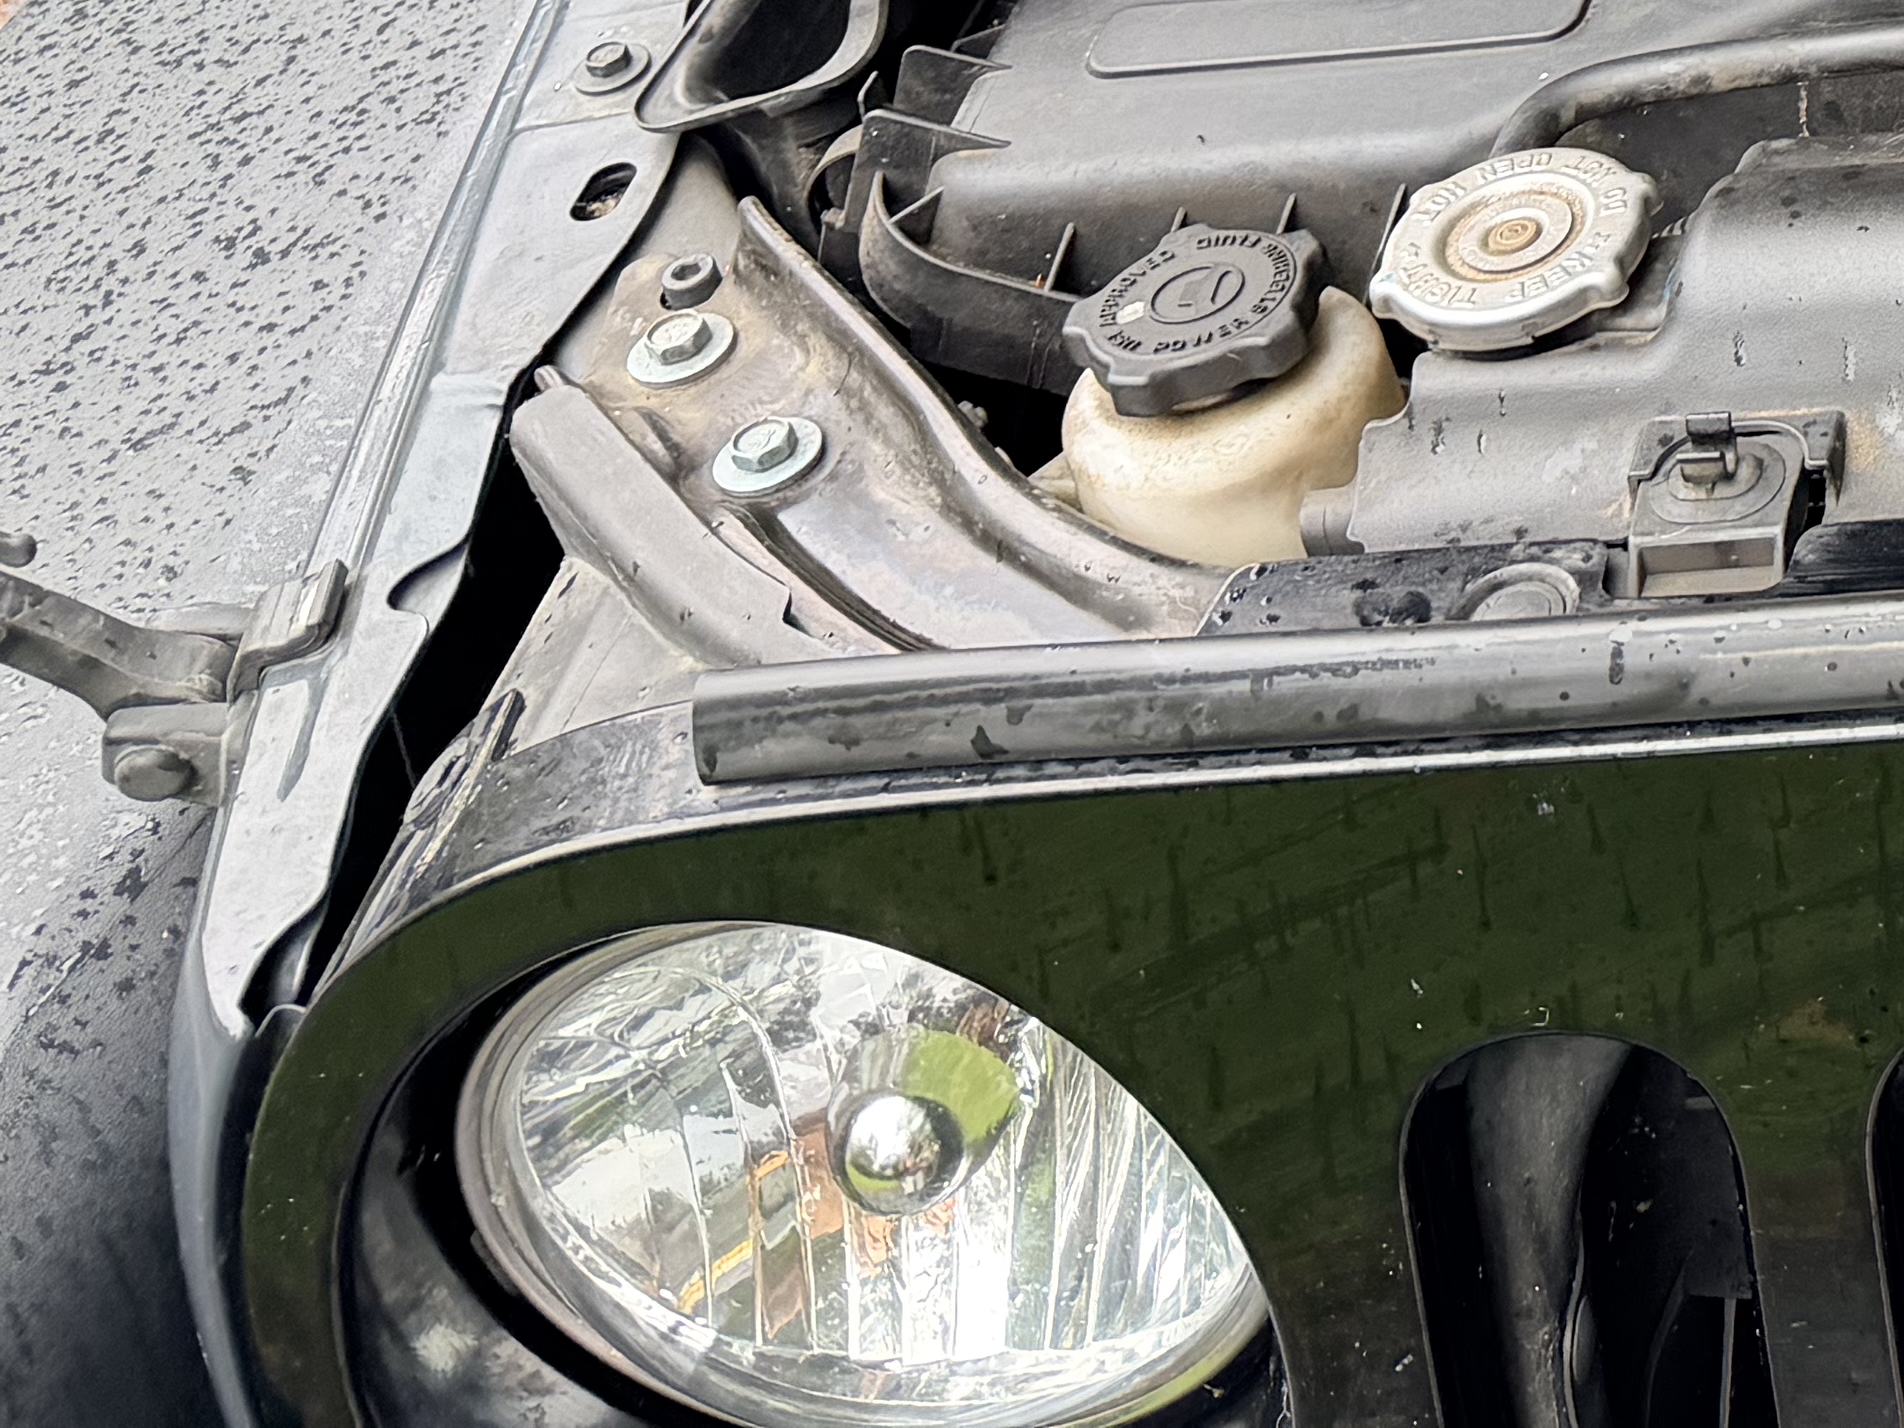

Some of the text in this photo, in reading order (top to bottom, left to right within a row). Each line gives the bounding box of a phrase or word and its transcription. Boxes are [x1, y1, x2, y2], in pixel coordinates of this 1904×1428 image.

[1476, 152, 1552, 184] OPEN
[1561, 155, 1617, 186] NOT
[1412, 180, 1469, 227] HOT
[1196, 233, 1262, 250] FLUID
[1399, 250, 1594, 309] KEEP TIGHT
